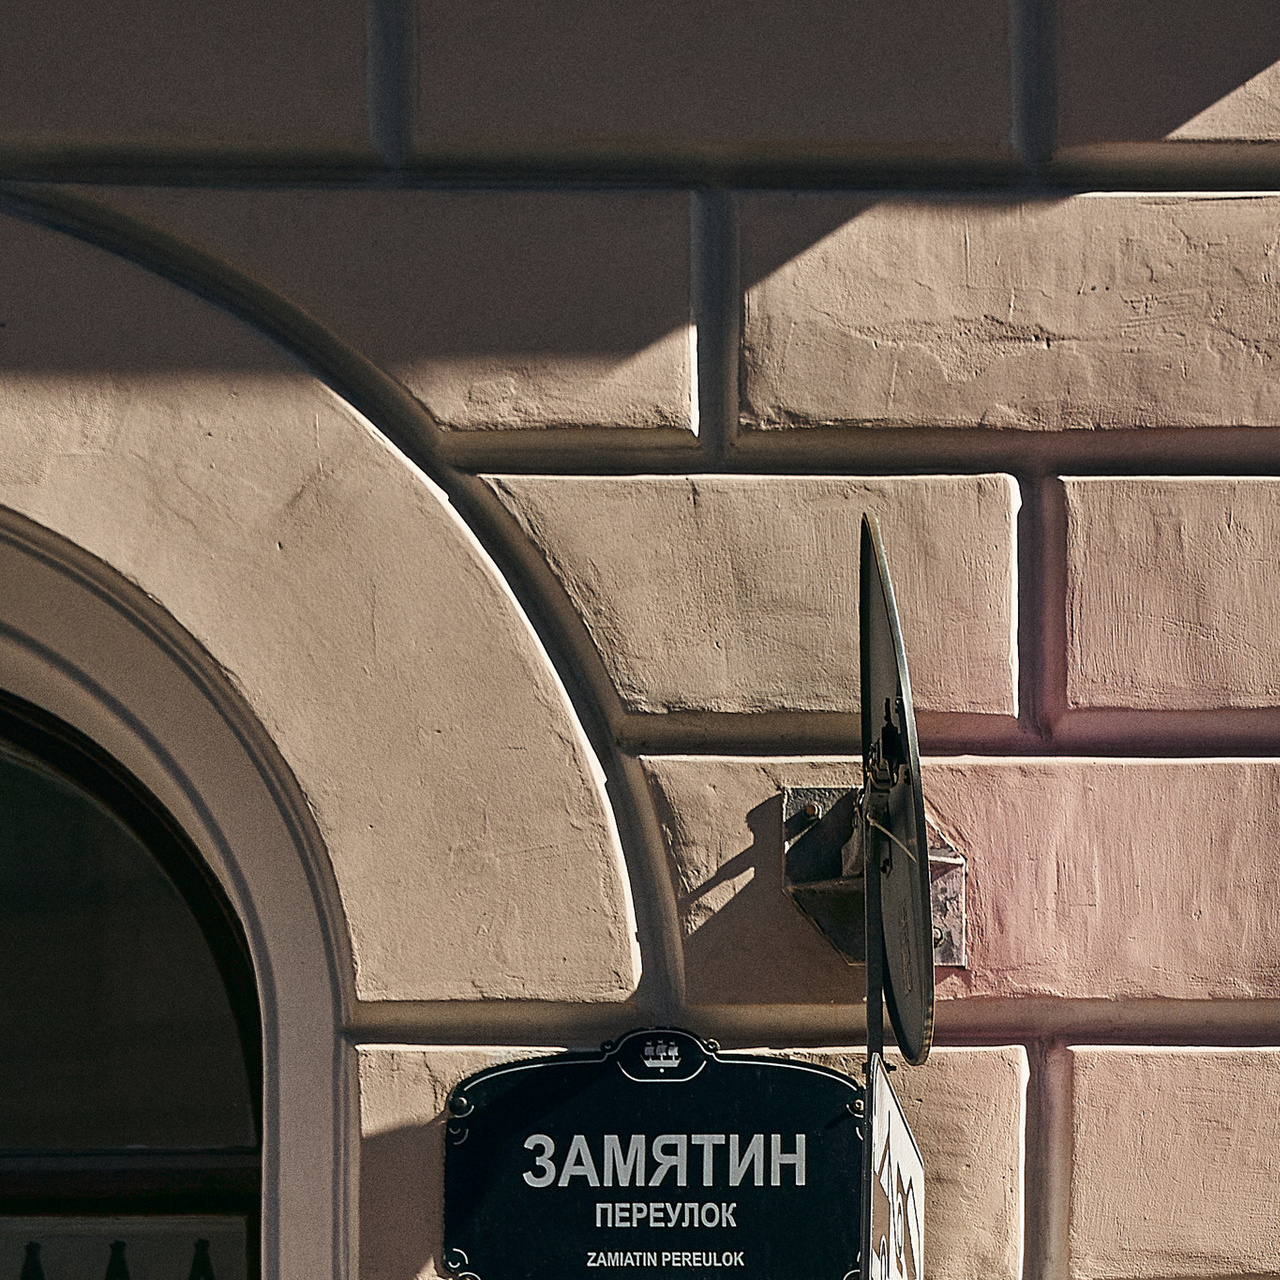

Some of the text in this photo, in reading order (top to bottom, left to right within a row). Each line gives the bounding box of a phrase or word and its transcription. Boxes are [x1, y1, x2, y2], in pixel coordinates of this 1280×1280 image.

[522, 1133, 806, 1188] ЗАМЯТИН
[595, 1202, 738, 1228] ПЕРЕУЛОК
[586, 1251, 745, 1268] ZAMIATIN PEREULOK
